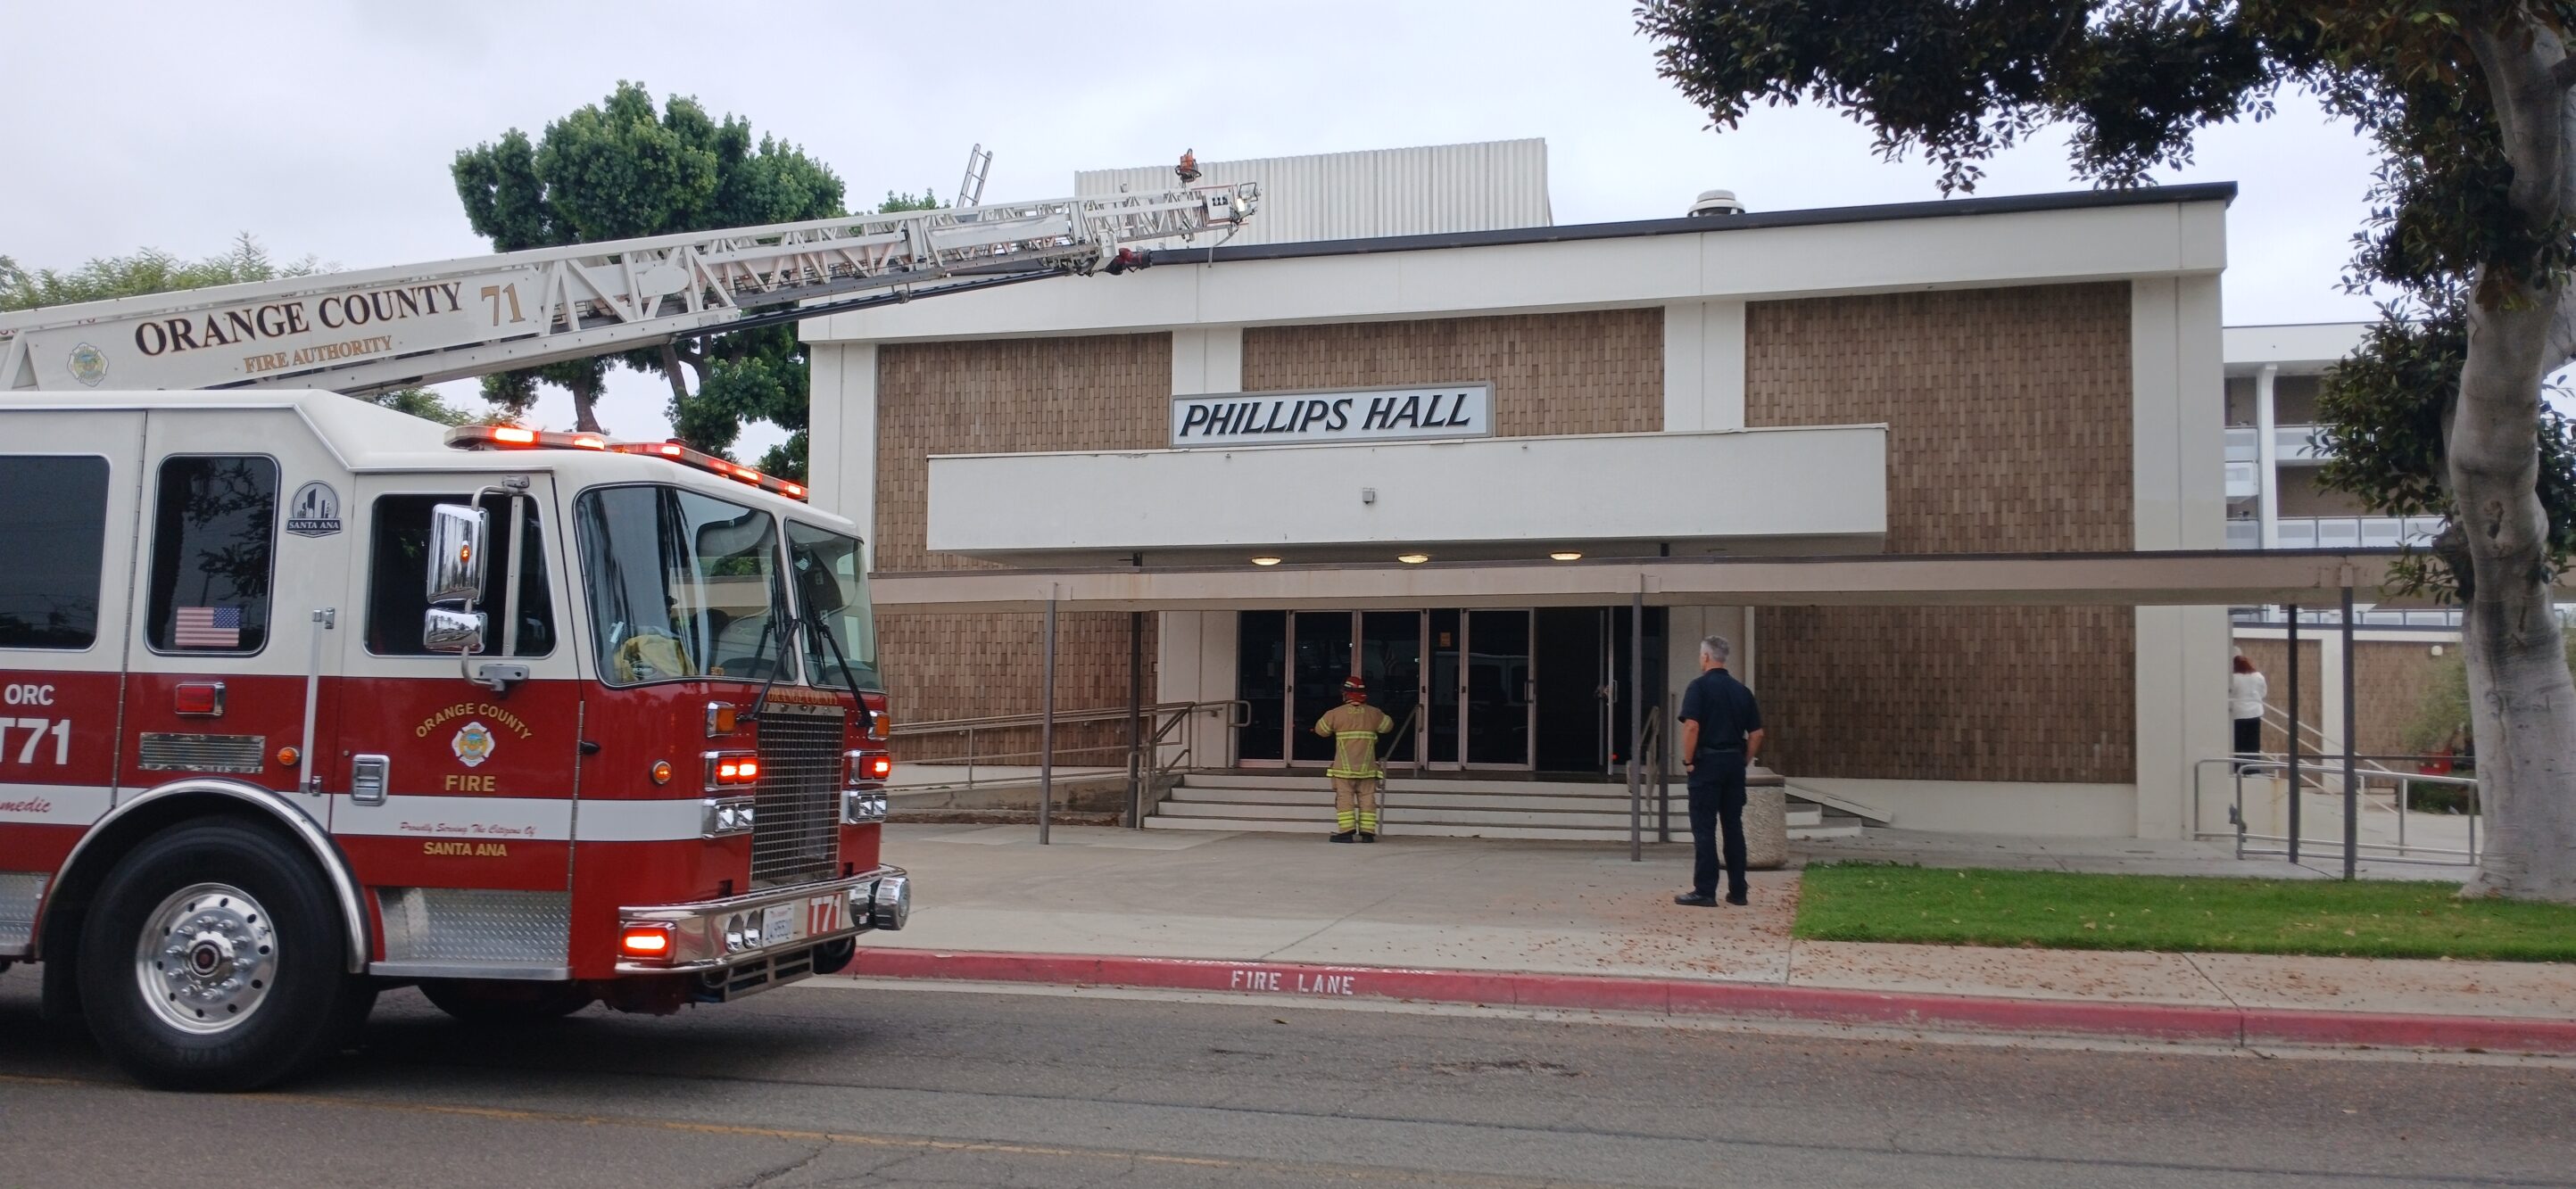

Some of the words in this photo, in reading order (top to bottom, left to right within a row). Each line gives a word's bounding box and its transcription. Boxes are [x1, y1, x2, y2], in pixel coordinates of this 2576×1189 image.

[135, 301, 311, 356] ORANGE
[319, 281, 462, 328] COUNTY
[481, 283, 526, 326] 71
[243, 352, 289, 373] FIRE
[292, 335, 392, 366] AUTHORITY
[1179, 398, 1353, 437] PHILLIPS
[1362, 393, 1470, 431] HALL
[288, 521, 318, 529] SANTA
[319, 521, 339, 529] ANA
[4, 683, 55, 706] ORC
[416, 702, 475, 738] ORANGE
[478, 703, 533, 739] COUNTY
[445, 774, 496, 792] FIRE
[471, 823, 485, 833] The
[423, 841, 472, 855] SANTA
[476, 843, 508, 857] ANA
[810, 894, 841, 934] T71
[1230, 970, 1282, 991] FIRE
[1297, 973, 1356, 995] LANE
